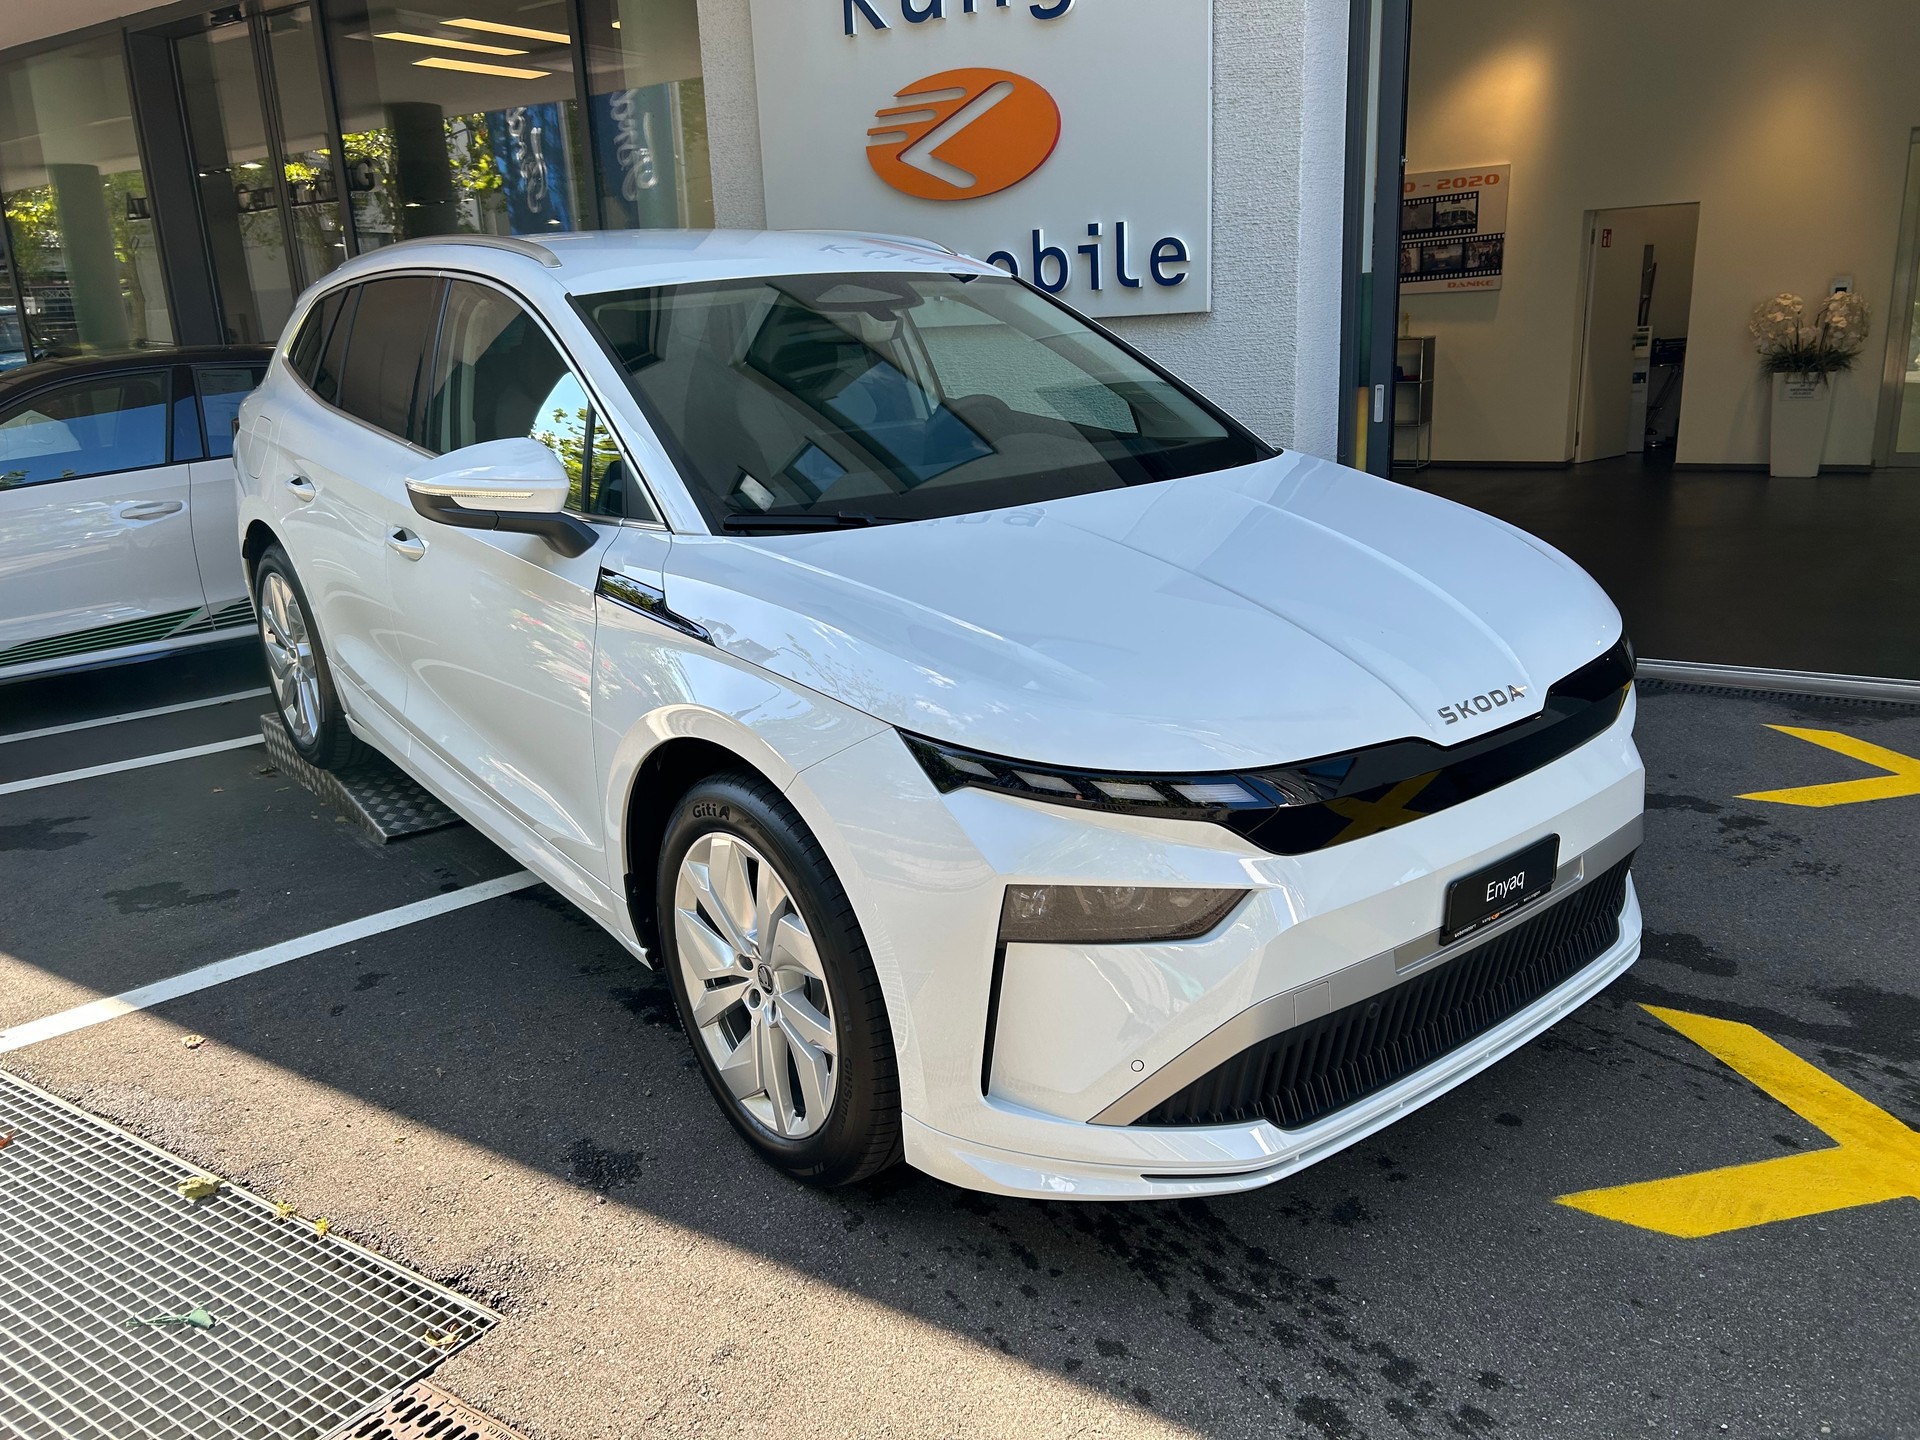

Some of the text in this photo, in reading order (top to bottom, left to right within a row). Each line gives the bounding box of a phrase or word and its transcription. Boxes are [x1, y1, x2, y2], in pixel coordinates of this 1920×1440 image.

[1437, 174, 1500, 190] 2020
[1447, 280, 1494, 289] DANKE
[692, 803, 717, 818] Giti
[1486, 871, 1525, 902] Enyaq
